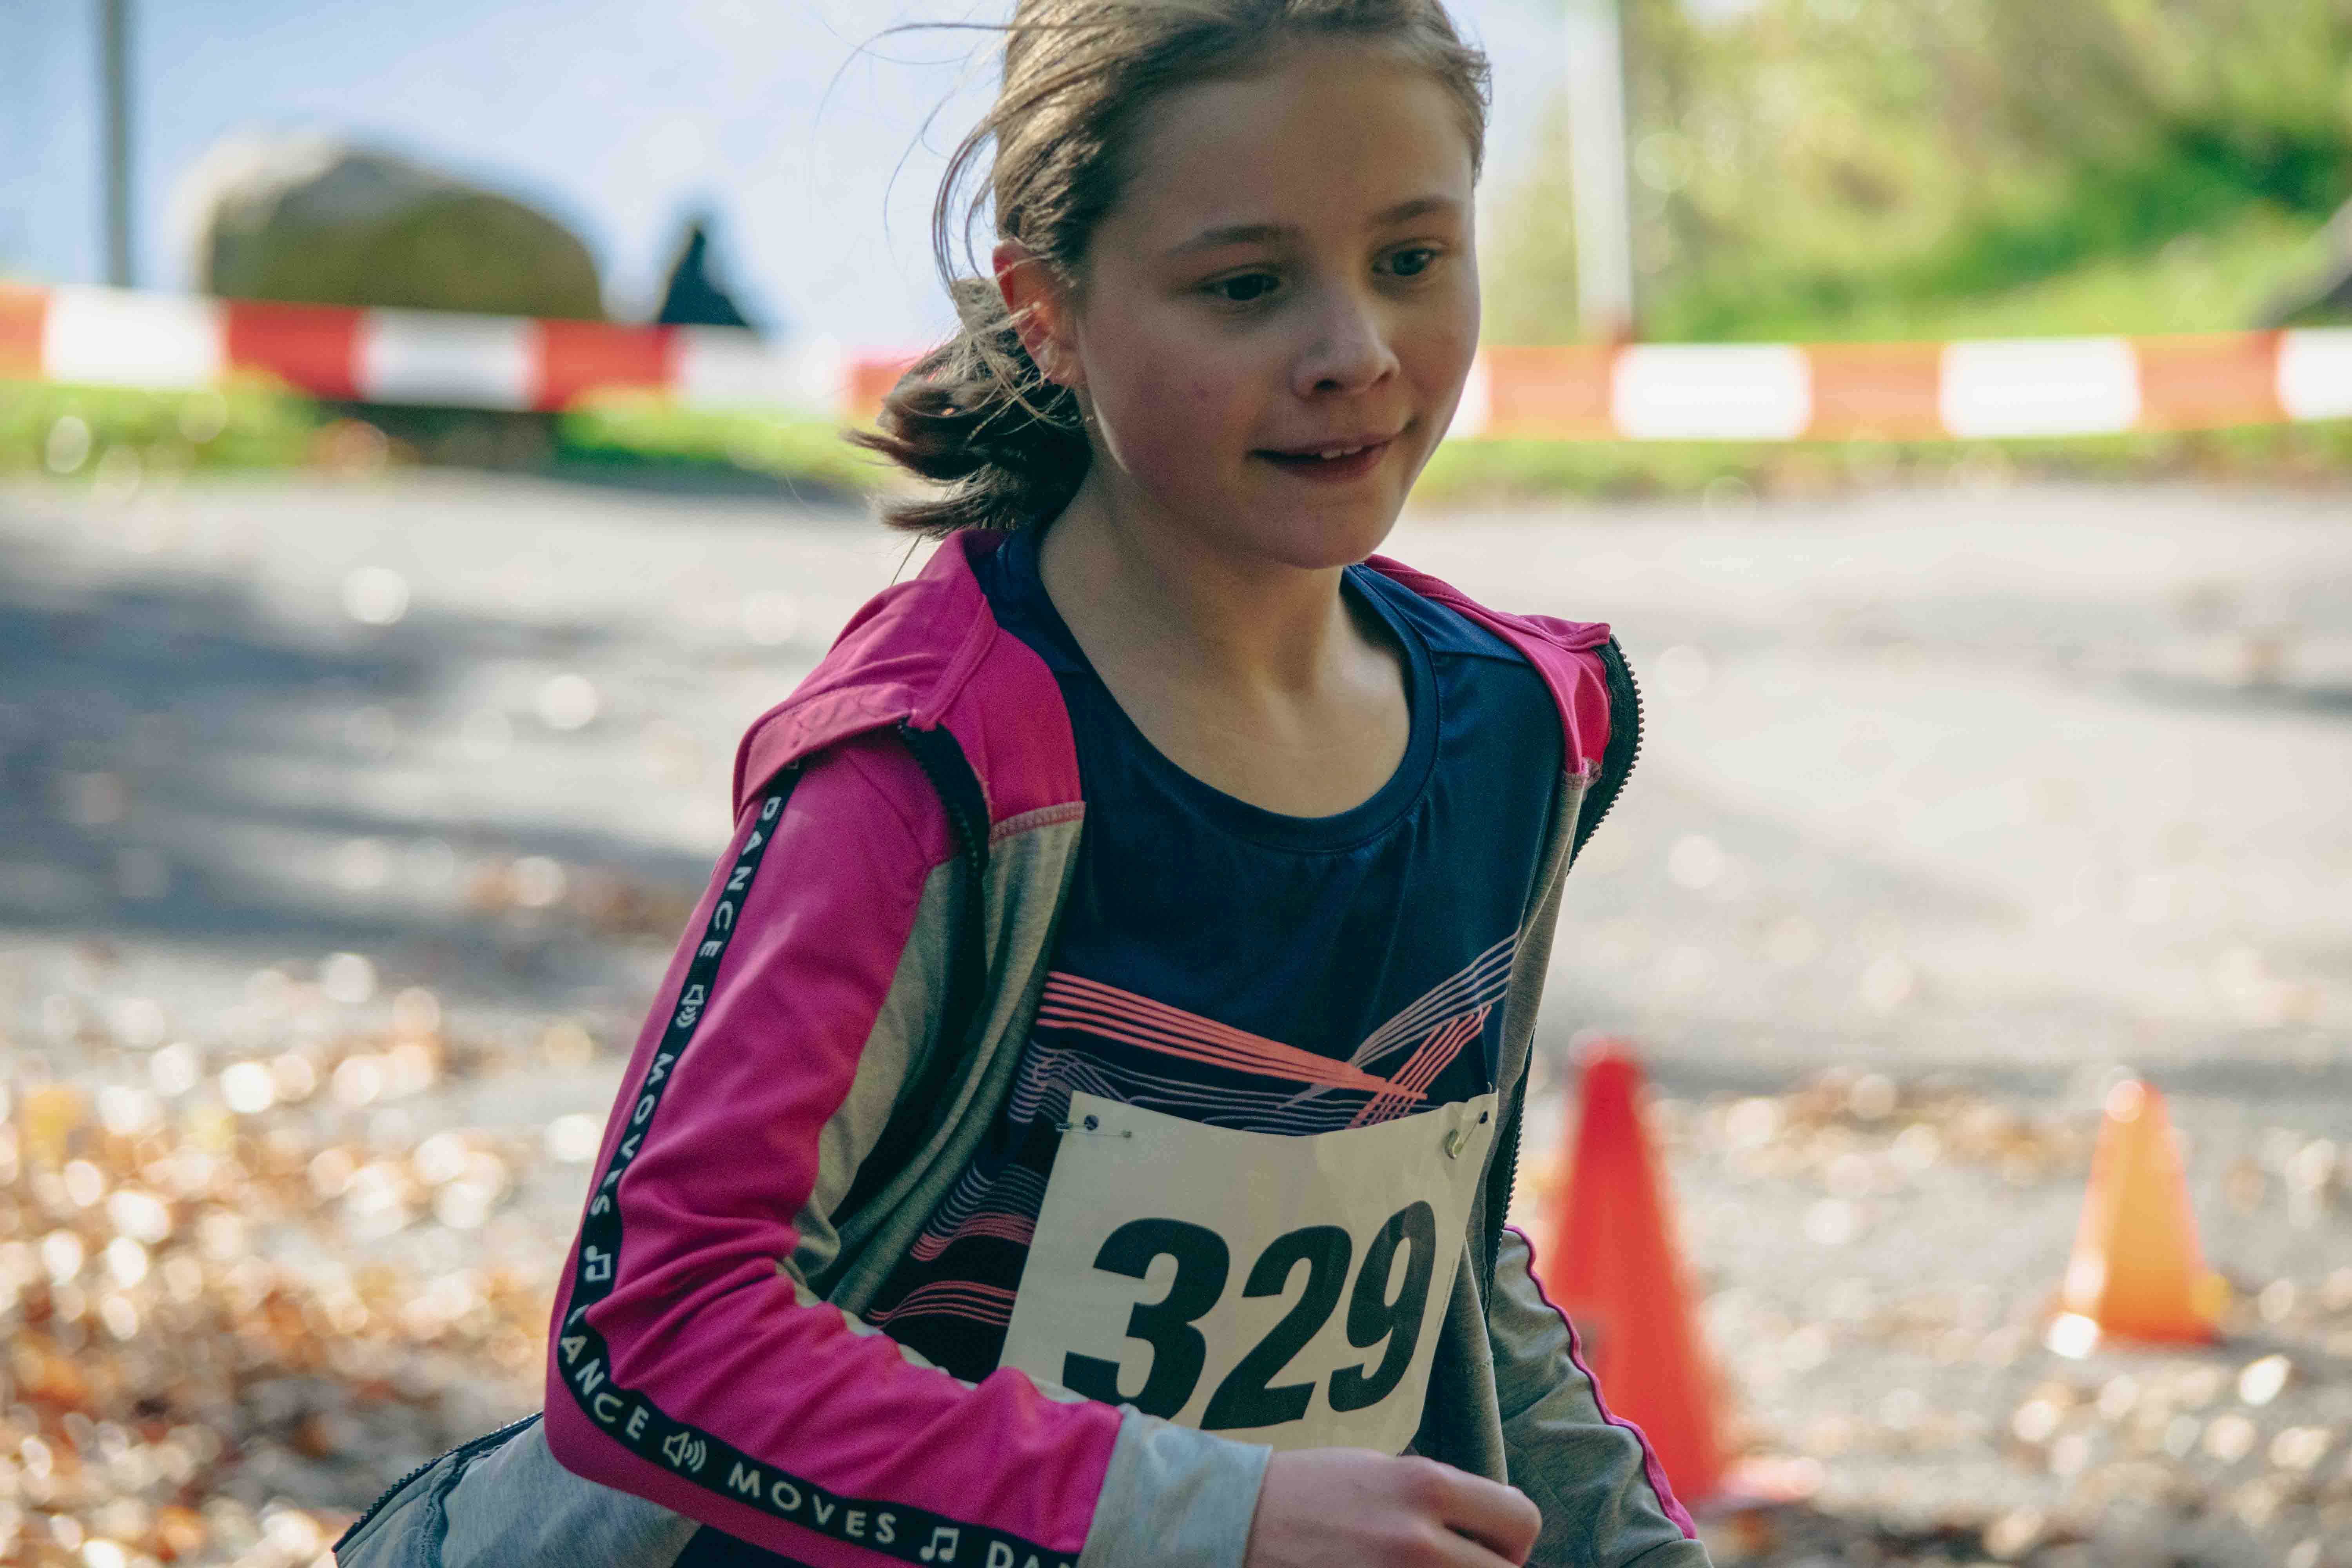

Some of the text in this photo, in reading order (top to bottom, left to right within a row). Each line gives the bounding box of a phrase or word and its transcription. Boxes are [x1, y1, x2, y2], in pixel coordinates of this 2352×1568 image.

[699, 796, 781, 958] DANCE
[1062, 1200, 1436, 1430] 329
[727, 1461, 897, 1544] MOVES
